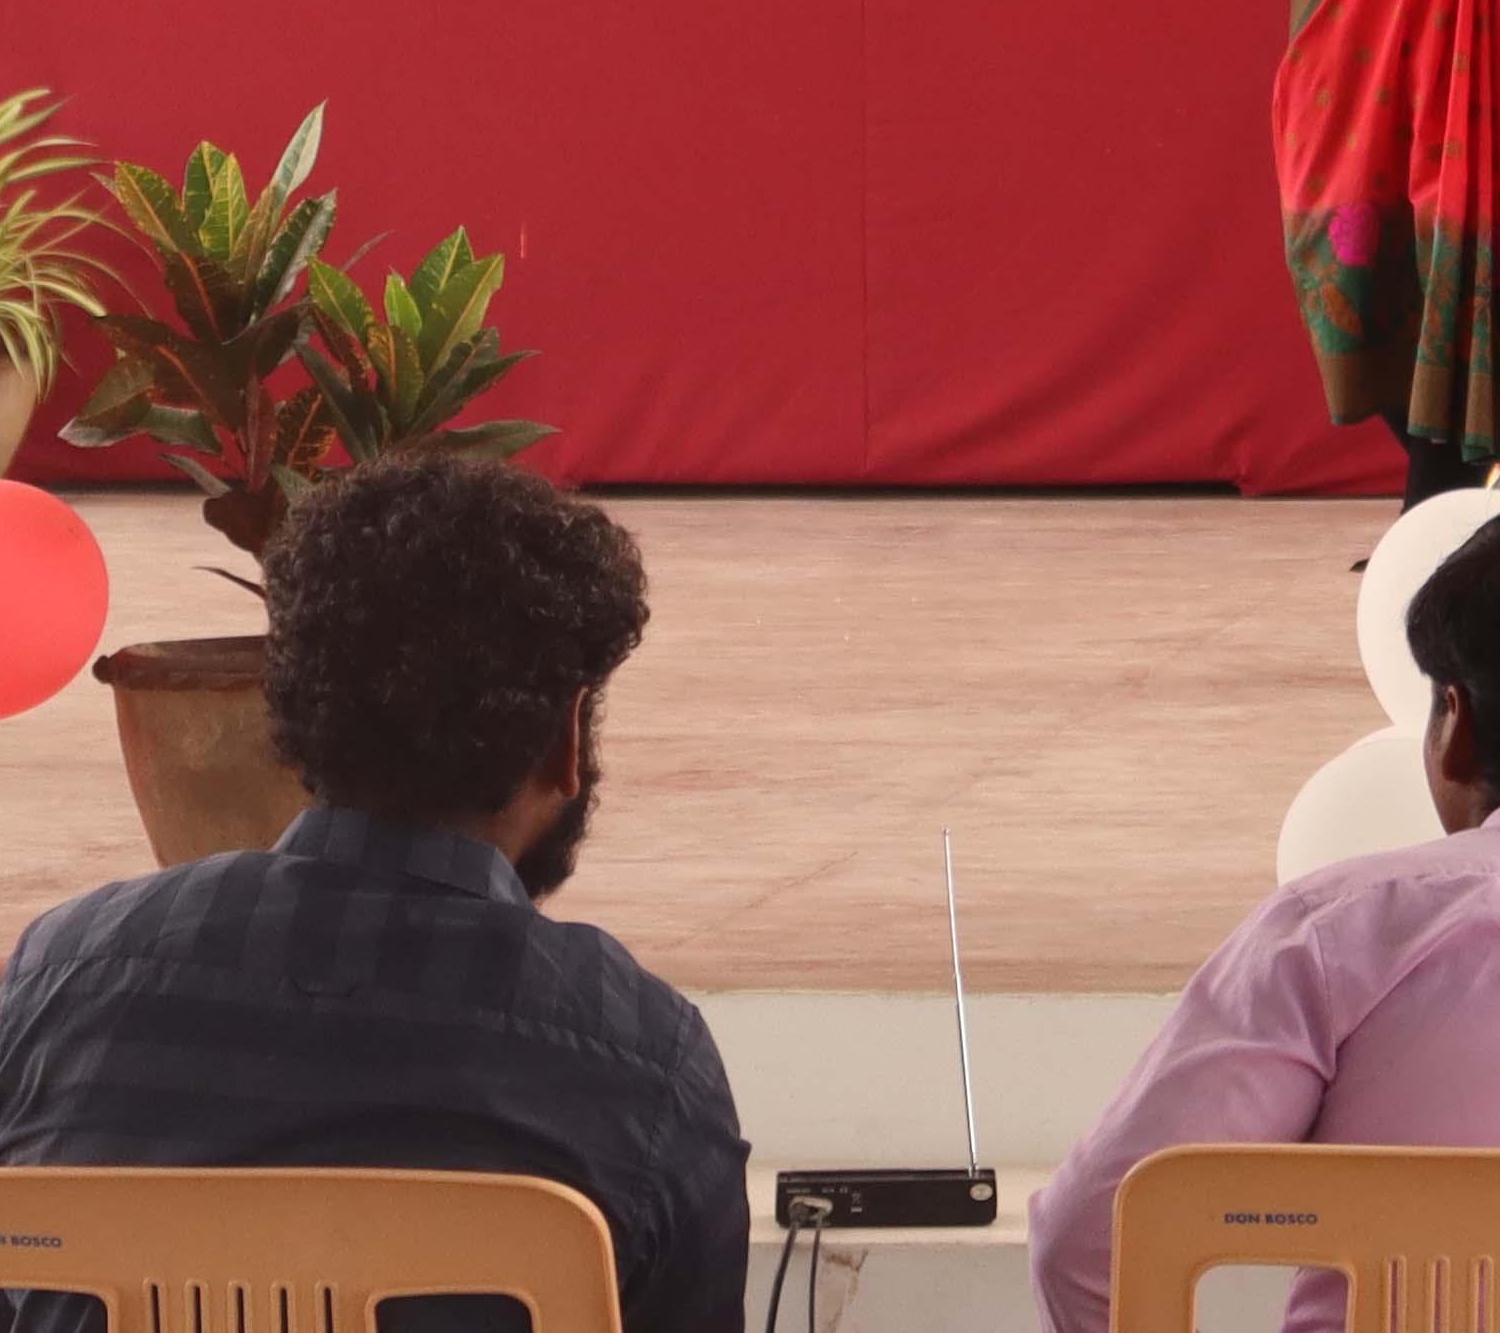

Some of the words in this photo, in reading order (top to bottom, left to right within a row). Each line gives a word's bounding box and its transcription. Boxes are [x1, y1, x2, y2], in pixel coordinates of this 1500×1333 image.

[1225, 1213, 1260, 1224] DON
[1266, 1213, 1318, 1225] BOSCO
[11, 1236, 63, 1247] BOSCO
